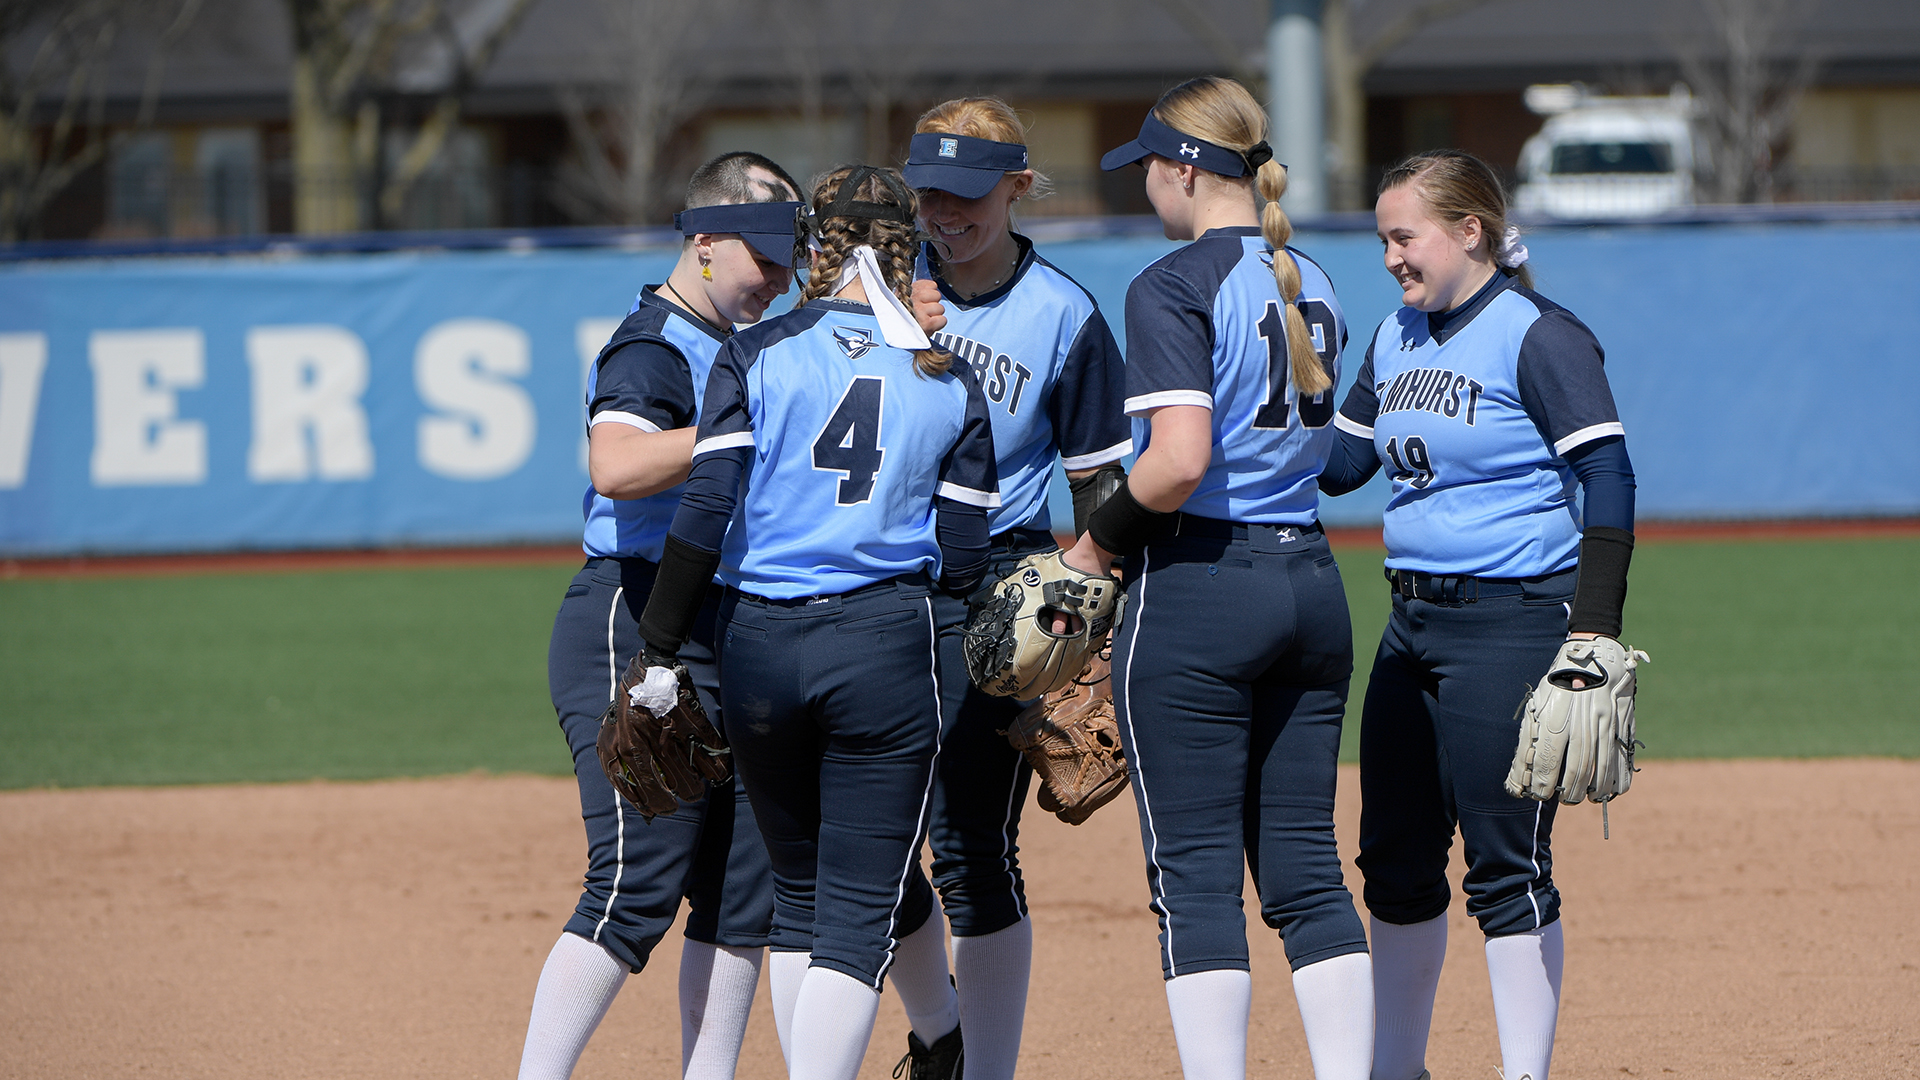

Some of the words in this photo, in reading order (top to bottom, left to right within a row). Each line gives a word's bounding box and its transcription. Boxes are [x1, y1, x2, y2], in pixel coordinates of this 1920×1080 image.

[939, 138, 958, 158] E
[1250, 298, 1338, 430] 13
[1376, 367, 1484, 427] MHURST
[810, 374, 886, 507] 4
[1385, 435, 1436, 490] 19
